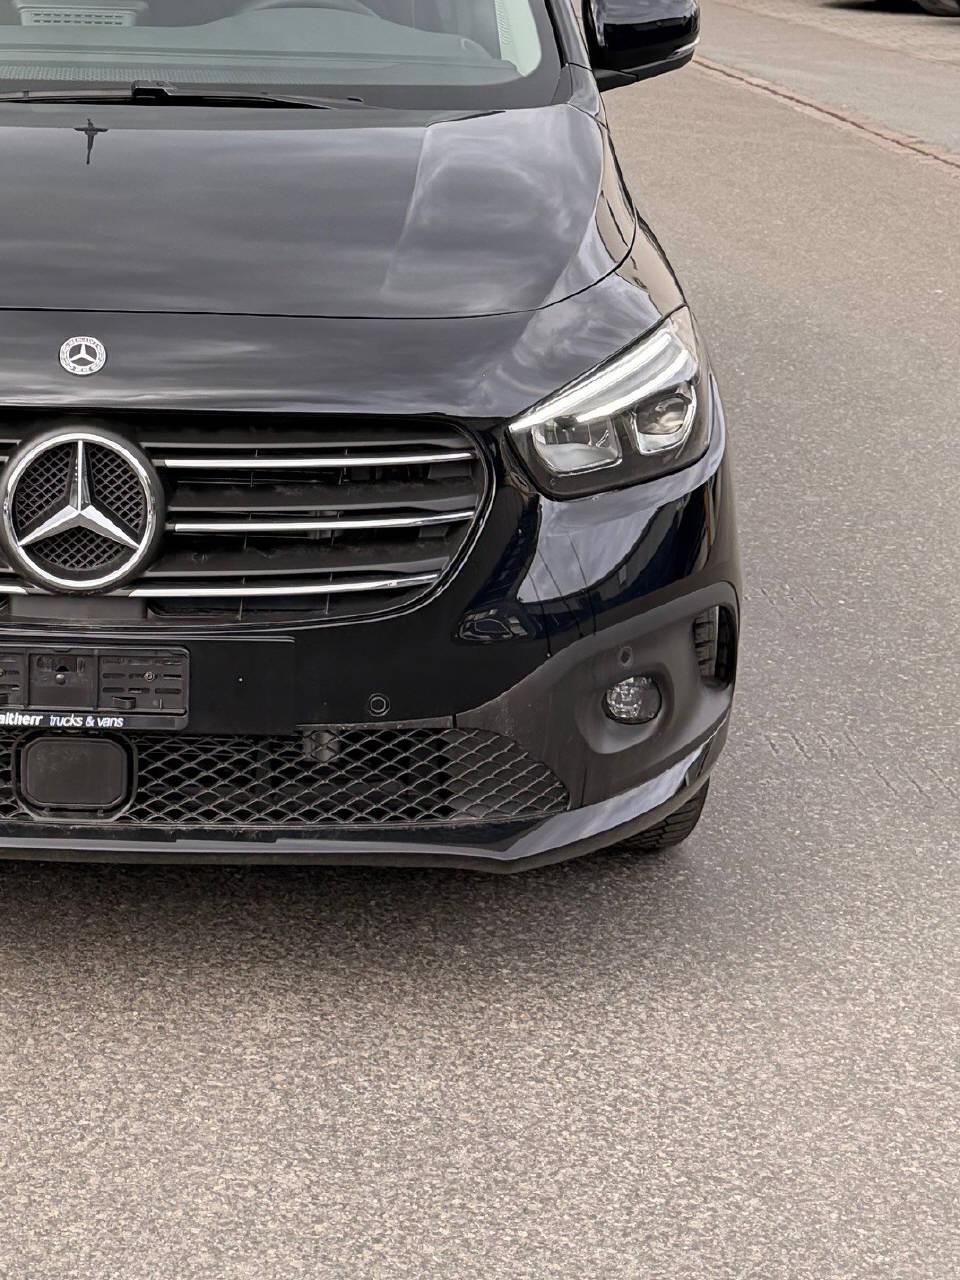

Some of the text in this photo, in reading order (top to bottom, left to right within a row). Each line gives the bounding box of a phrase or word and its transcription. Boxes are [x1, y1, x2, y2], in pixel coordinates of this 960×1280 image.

[49, 714, 83, 727] trucks
[85, 716, 95, 727] &
[97, 717, 124, 728] vans
